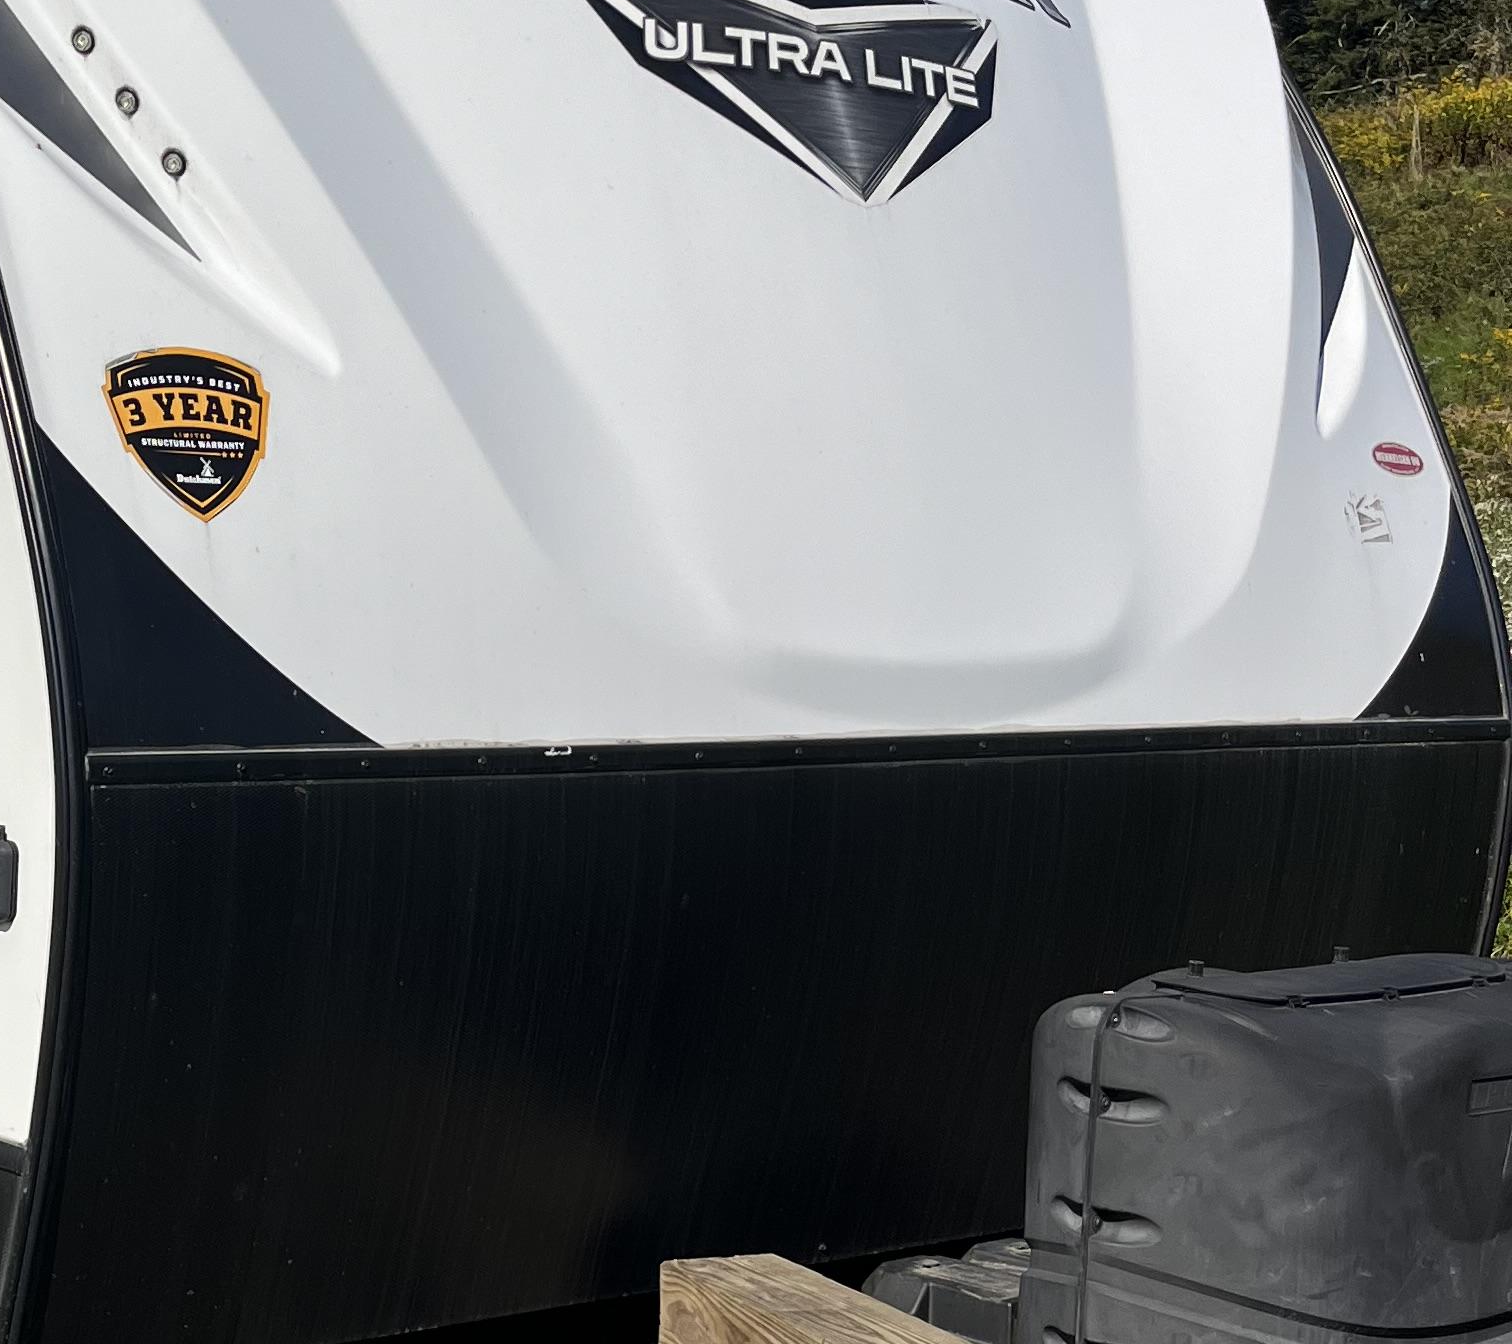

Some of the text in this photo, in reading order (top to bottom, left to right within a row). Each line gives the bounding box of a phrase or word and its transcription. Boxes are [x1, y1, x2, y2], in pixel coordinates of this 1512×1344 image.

[643, 17, 981, 109] ULTRA LITE
[127, 374, 241, 392] INDUSTRY'S BEST
[122, 392, 253, 431] 3 YEAR
[141, 437, 245, 450] STRUCTURAL WARRANTY
